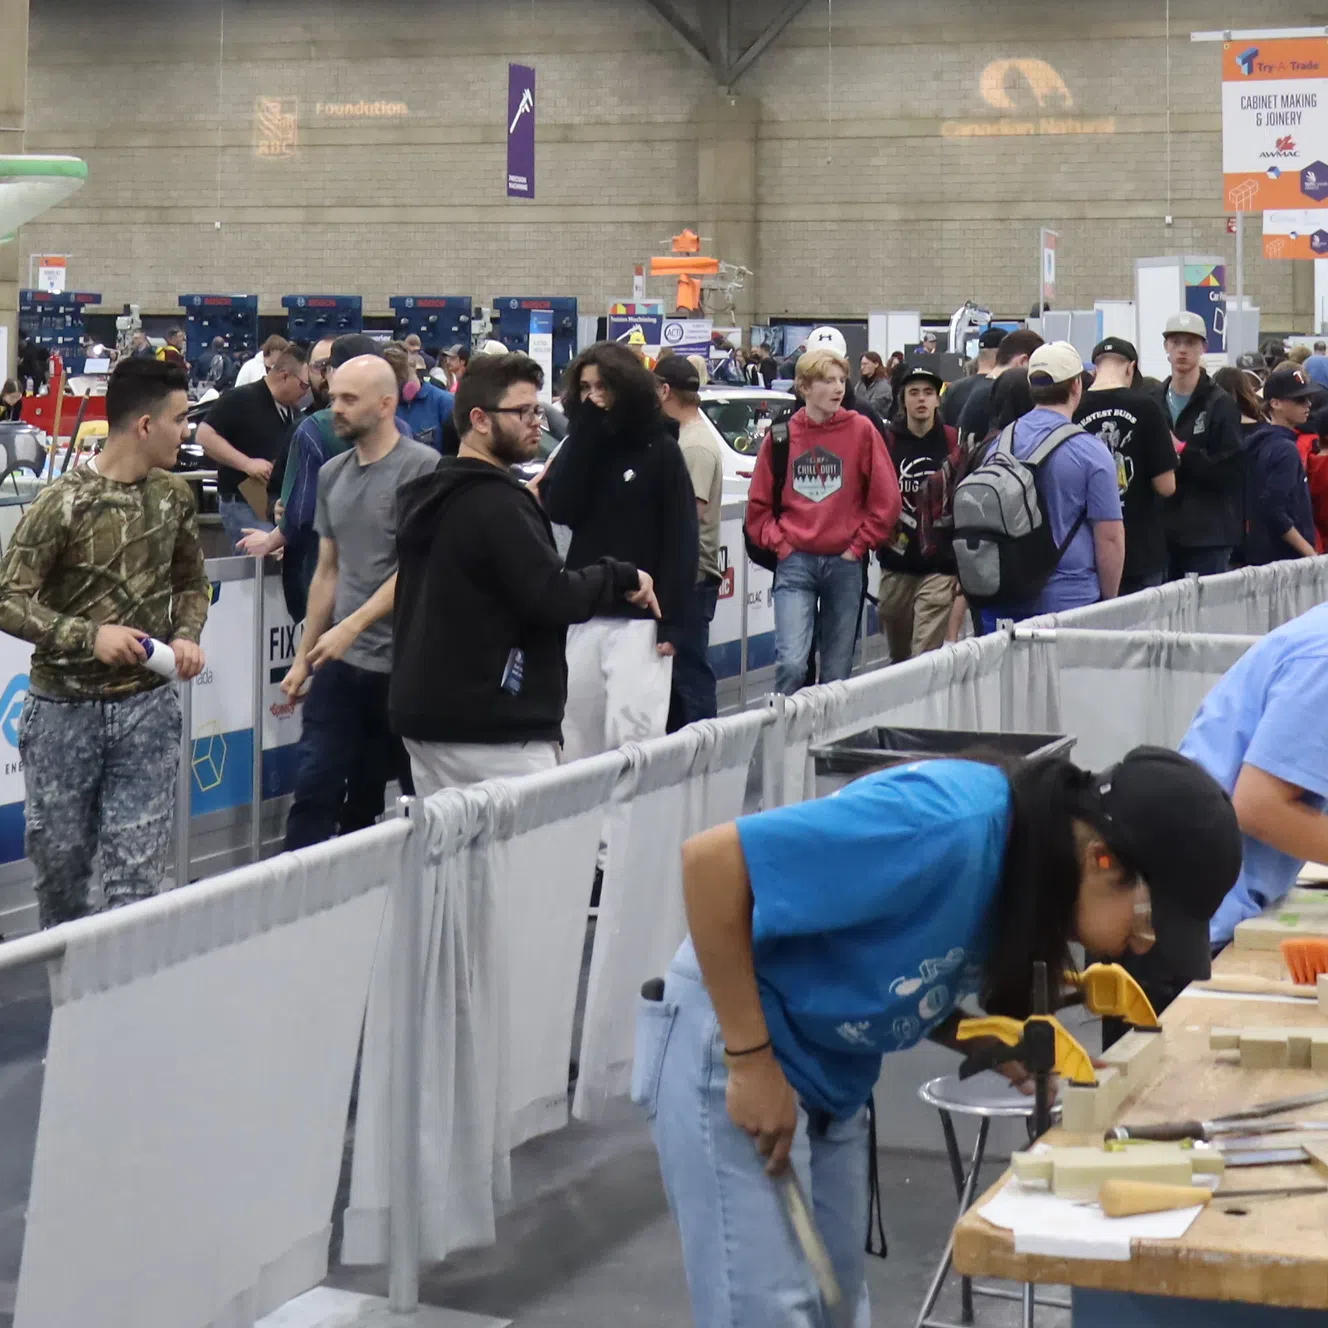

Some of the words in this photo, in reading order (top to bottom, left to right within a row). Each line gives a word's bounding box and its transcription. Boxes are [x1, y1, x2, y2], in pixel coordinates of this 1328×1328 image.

[1240, 95, 1277, 110] CABINET
[1281, 93, 1317, 108] MAKING
[1266, 112, 1302, 126] JOINERY
[1113, 409, 1137, 424] BUDS
[797, 464, 817, 474] CHILL
[821, 463, 837, 474] OUT!
[270, 625, 296, 661] FIX
